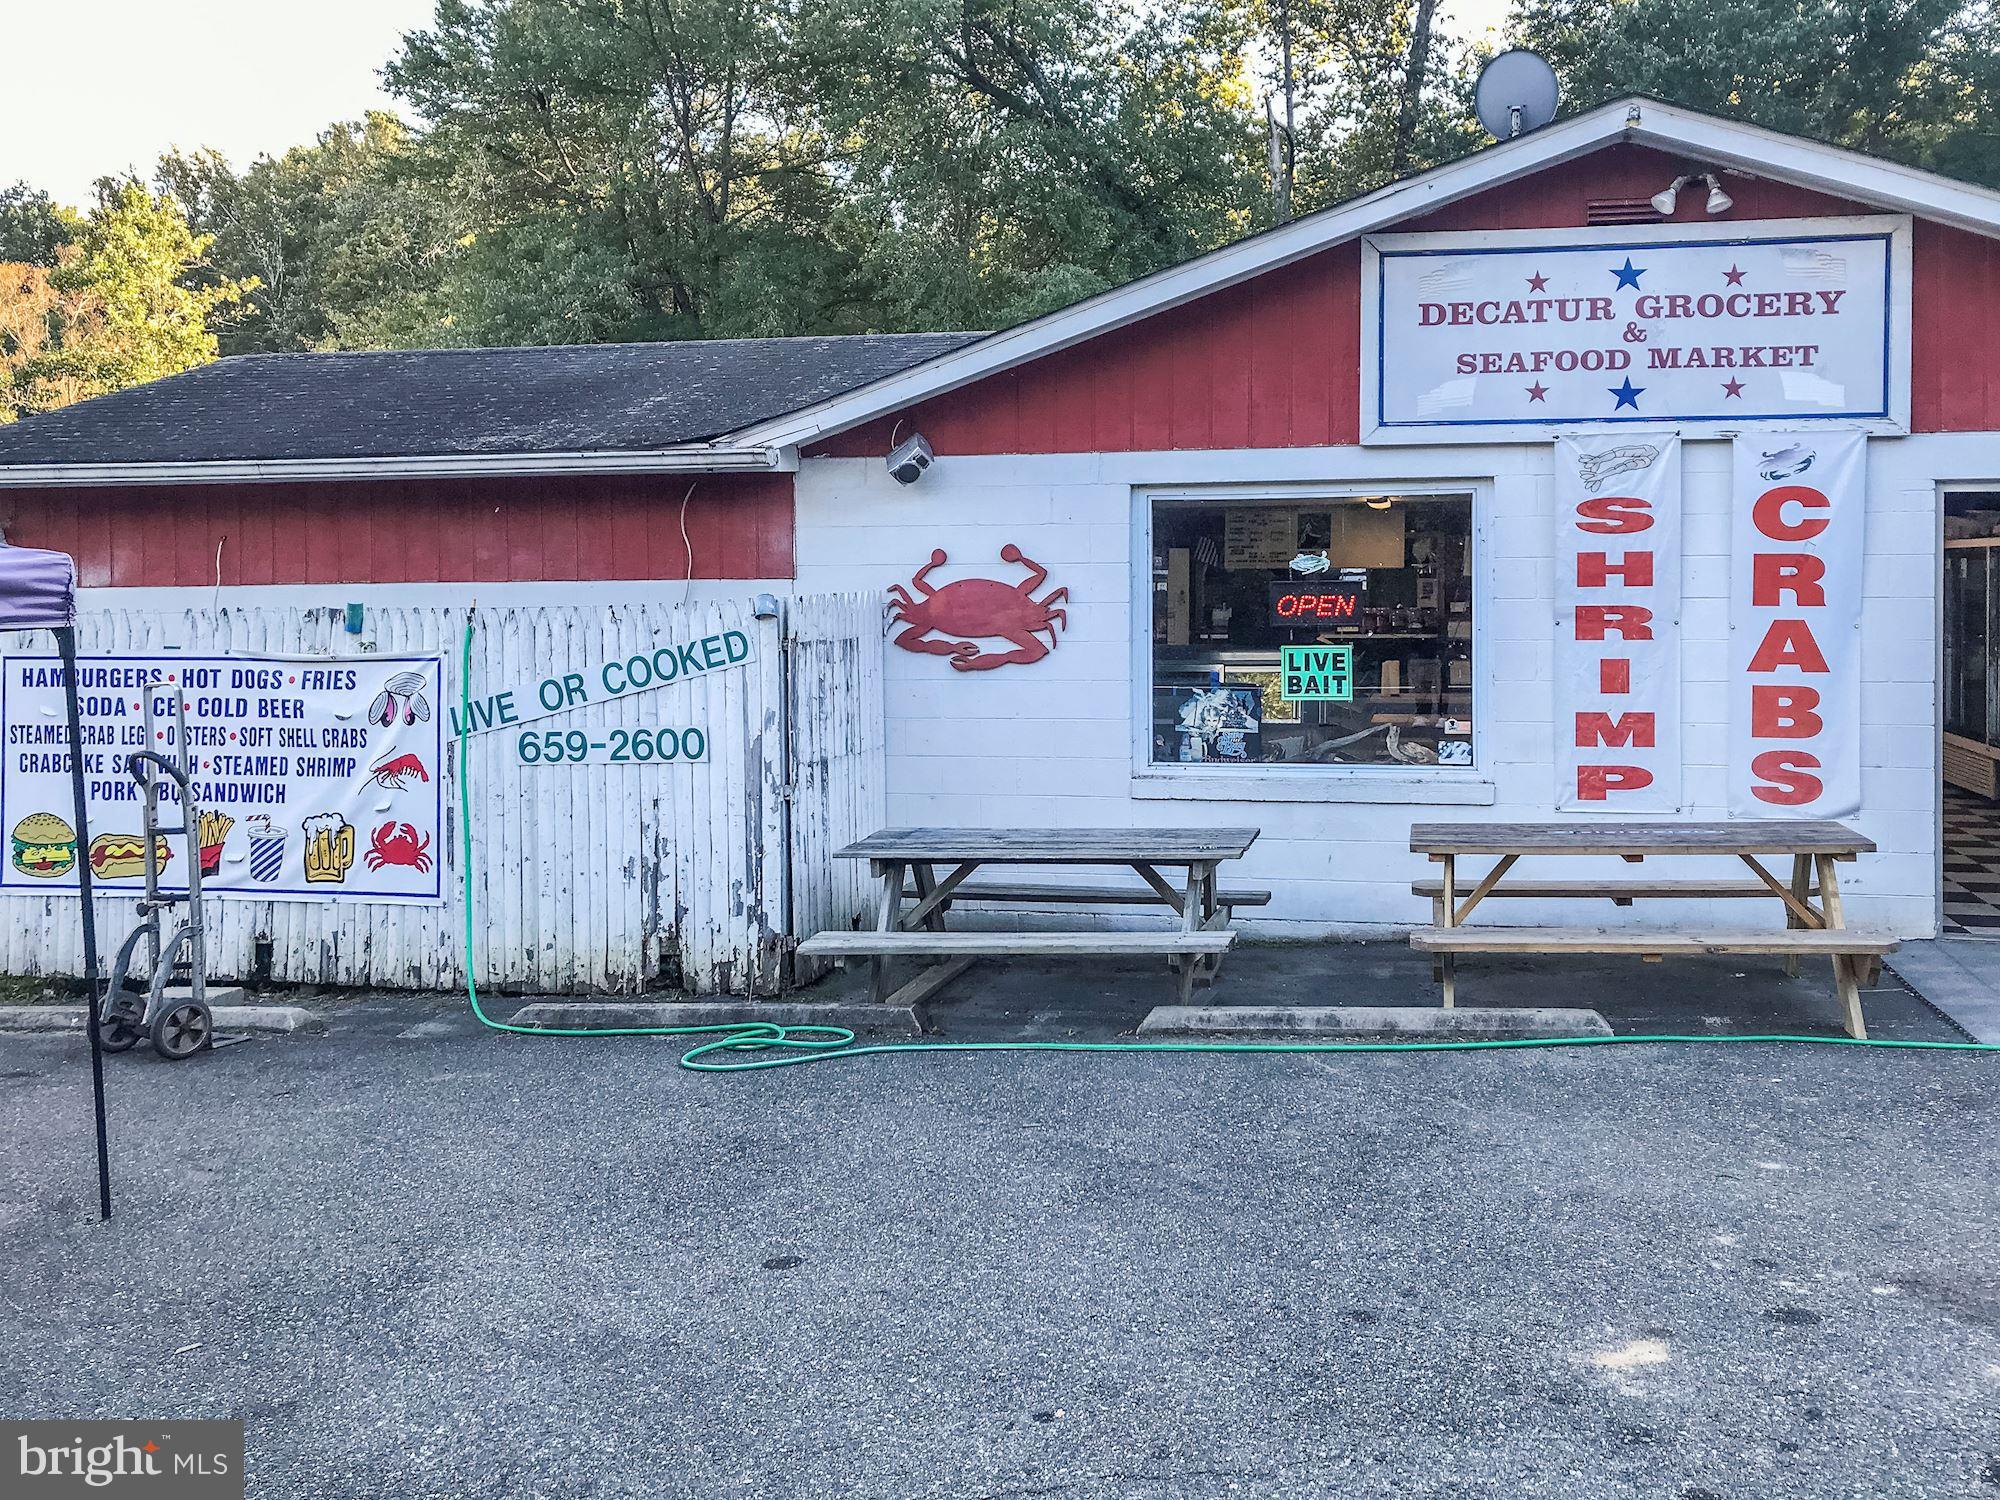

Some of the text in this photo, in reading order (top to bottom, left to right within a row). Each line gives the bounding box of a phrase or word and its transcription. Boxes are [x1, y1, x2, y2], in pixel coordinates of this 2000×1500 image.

[1418, 290, 1846, 326] DECATUR GROCERY
[1622, 322, 1647, 343] &
[1456, 345, 1819, 374] SEAFOOD MARKET
[1277, 594, 1356, 616] OPEN
[1575, 497, 1655, 800] SHRIMP
[1746, 486, 1831, 805] CRABS
[1288, 653, 1345, 671] LIVE
[182, 669, 221, 688] HOT
[232, 669, 283, 690] DOGS
[301, 670, 357, 690] FRIES
[450, 630, 748, 736] LIVE OR COOKED
[1287, 675, 1346, 694] BAIT
[153, 697, 176, 716] CE
[198, 697, 248, 717] COLD
[258, 699, 304, 718] BEER
[121, 726, 145, 745] LEG
[167, 726, 226, 746] OSTERS
[239, 727, 273, 747] SOFT
[279, 728, 317, 748] SHELL
[322, 728, 368, 748] CRABS
[518, 728, 705, 762] 659-2600
[19, 753, 104, 773] CRABCKE
[213, 755, 288, 776] STEAMED
[296, 757, 356, 777] SHRIMP
[91, 780, 286, 804] PORK BQ SANDWICH
